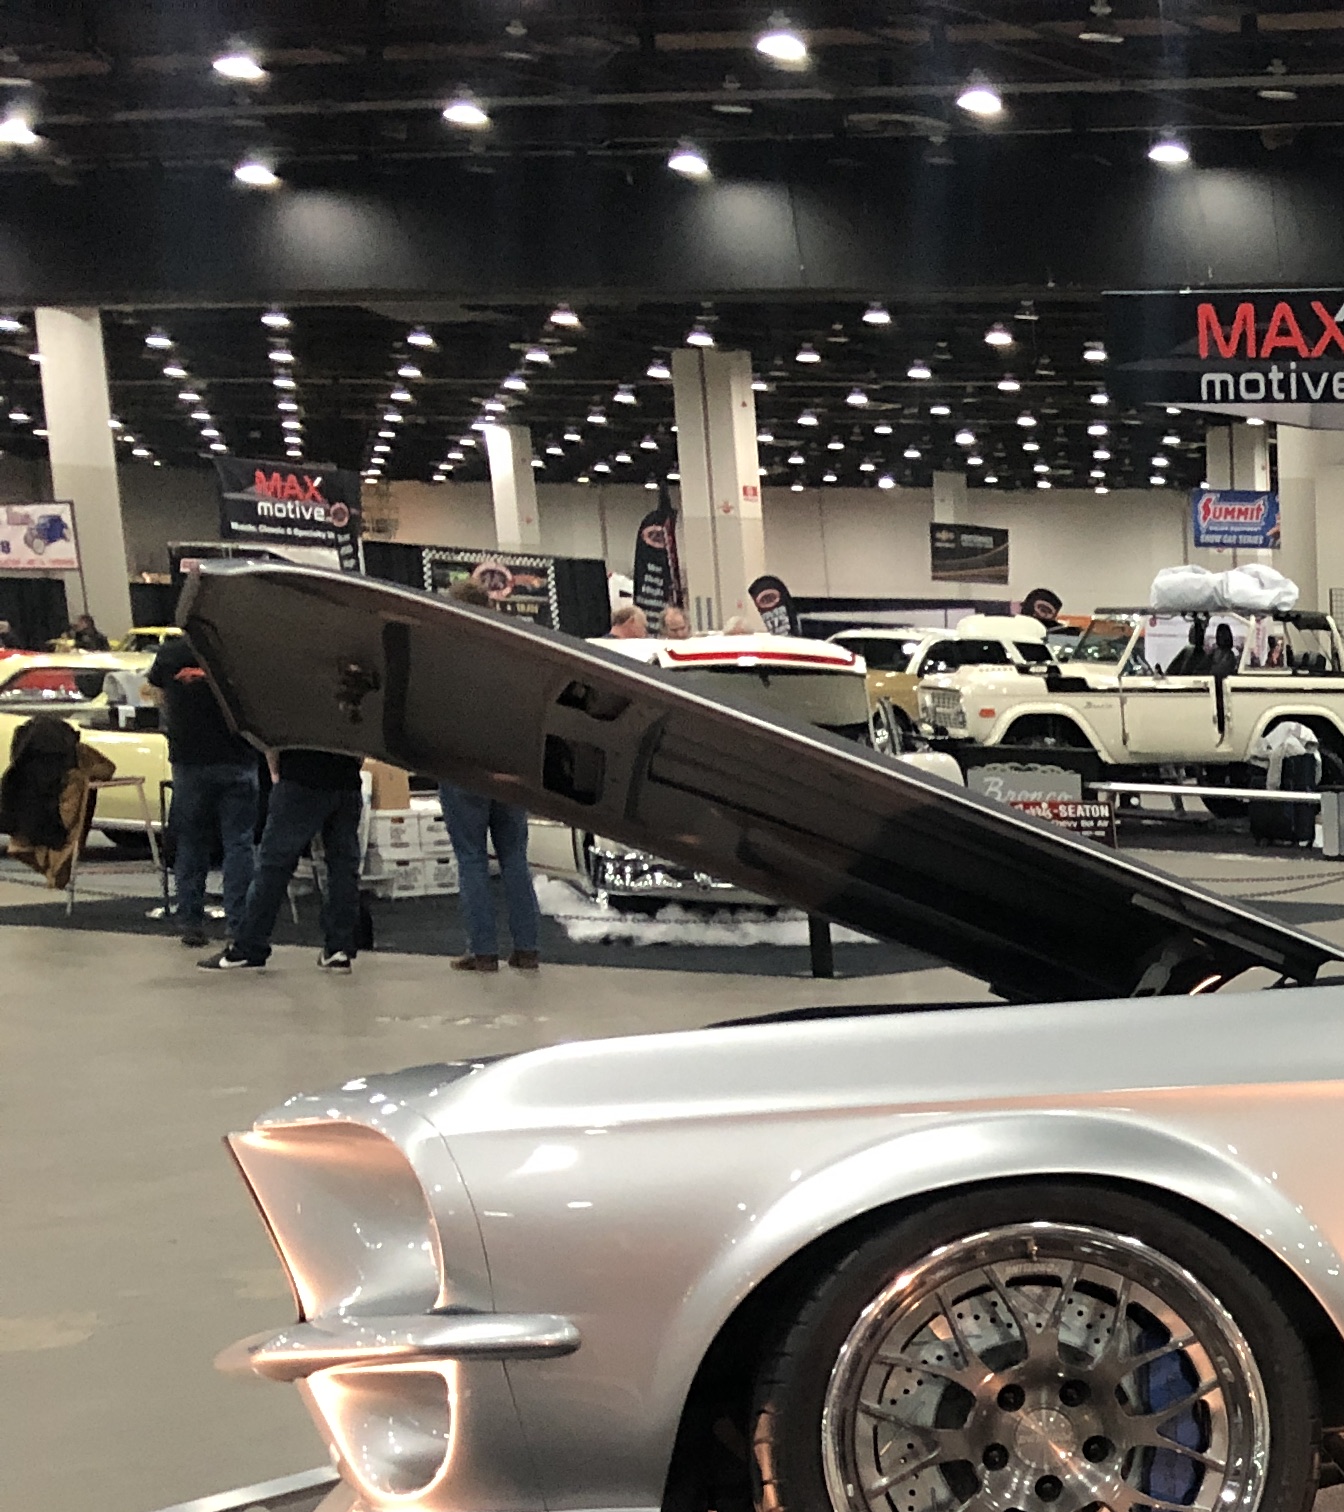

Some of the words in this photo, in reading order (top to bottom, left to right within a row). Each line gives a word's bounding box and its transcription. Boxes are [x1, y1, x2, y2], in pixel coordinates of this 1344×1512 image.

[254, 469, 328, 502] MAX
[257, 500, 325, 522] motive
[983, 776, 1073, 804] Bronco
